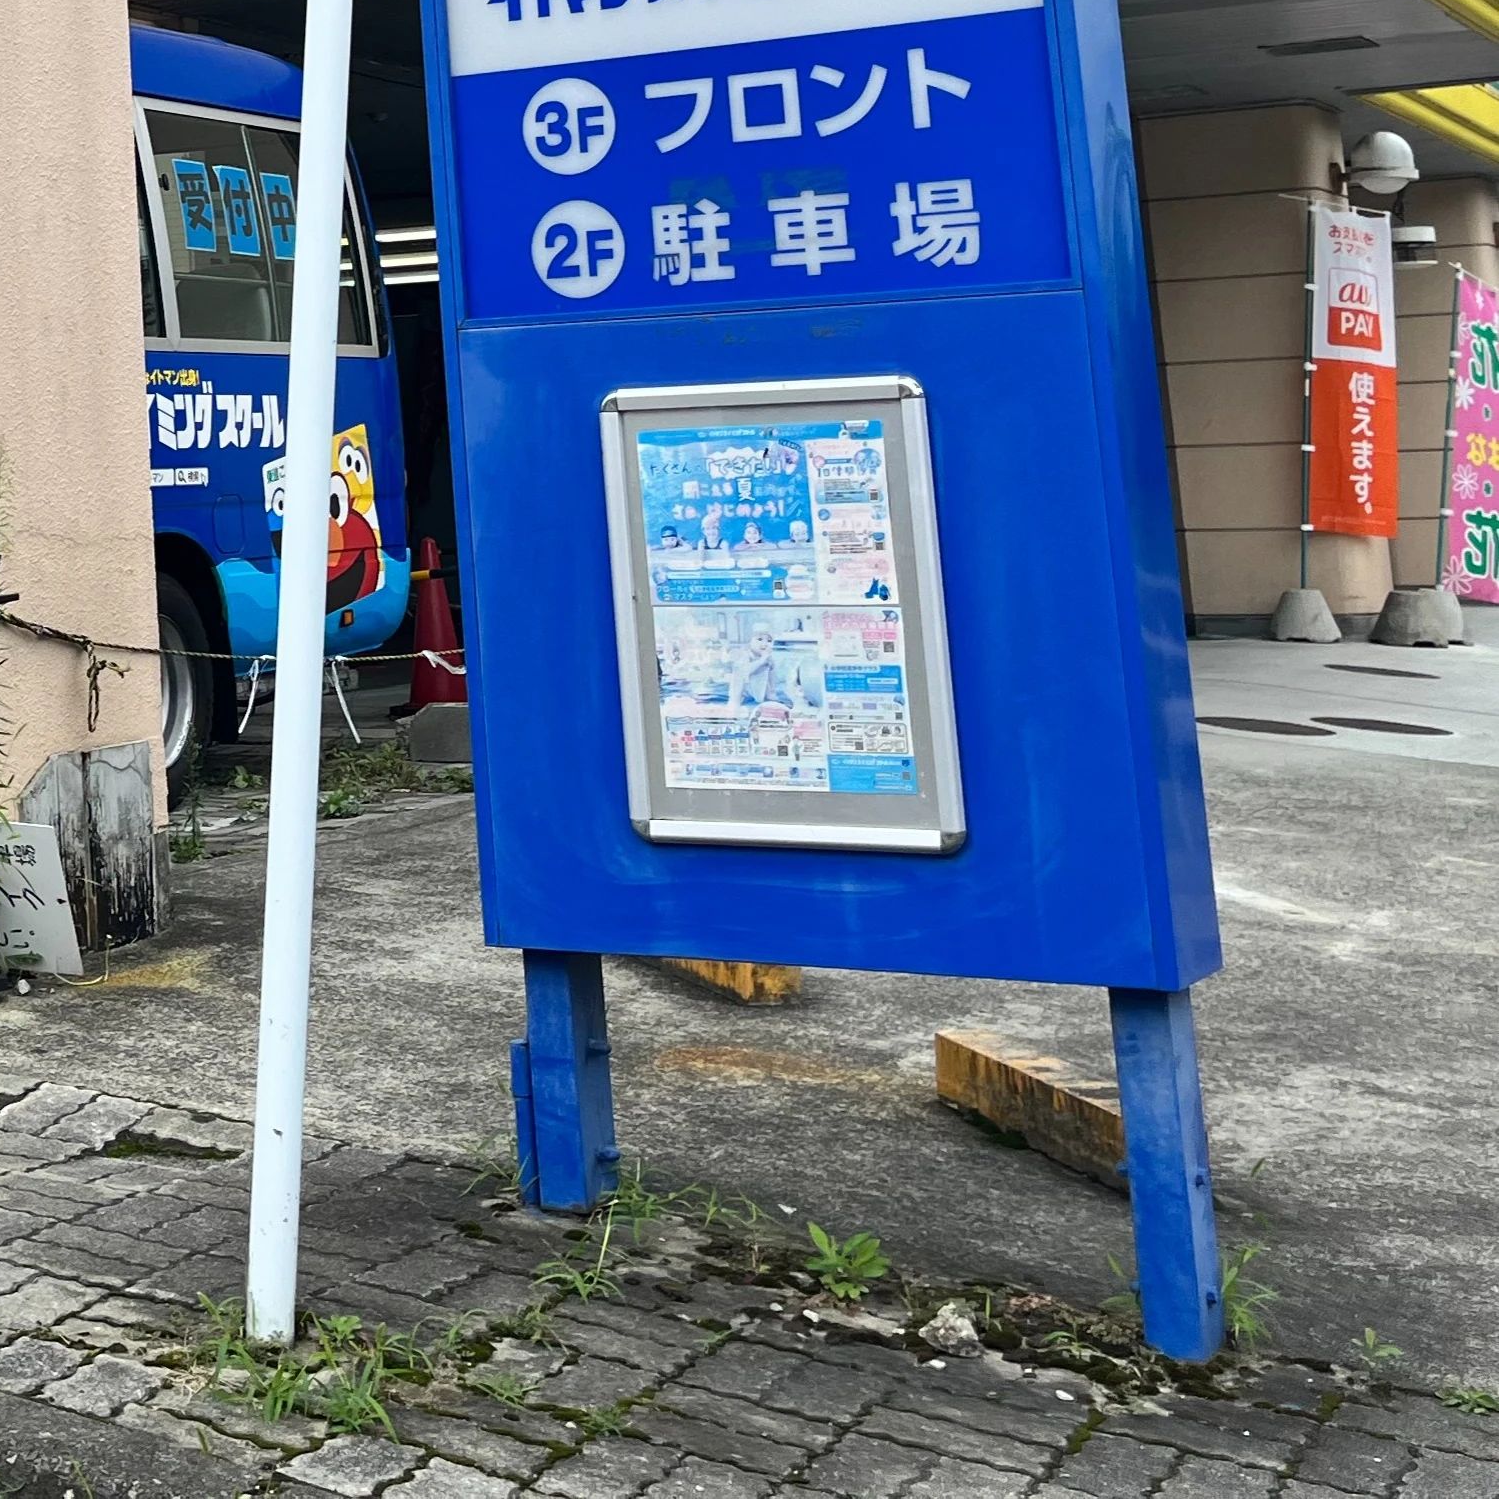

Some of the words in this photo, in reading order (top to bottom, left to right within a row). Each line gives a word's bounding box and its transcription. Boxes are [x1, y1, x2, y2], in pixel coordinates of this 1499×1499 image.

[535, 100, 605, 158] 3F
[644, 47, 972, 153] フロント
[545, 222, 614, 280] 2F
[651, 178, 981, 286] 駐車場
[1348, 372, 1376, 514] 使えます。
